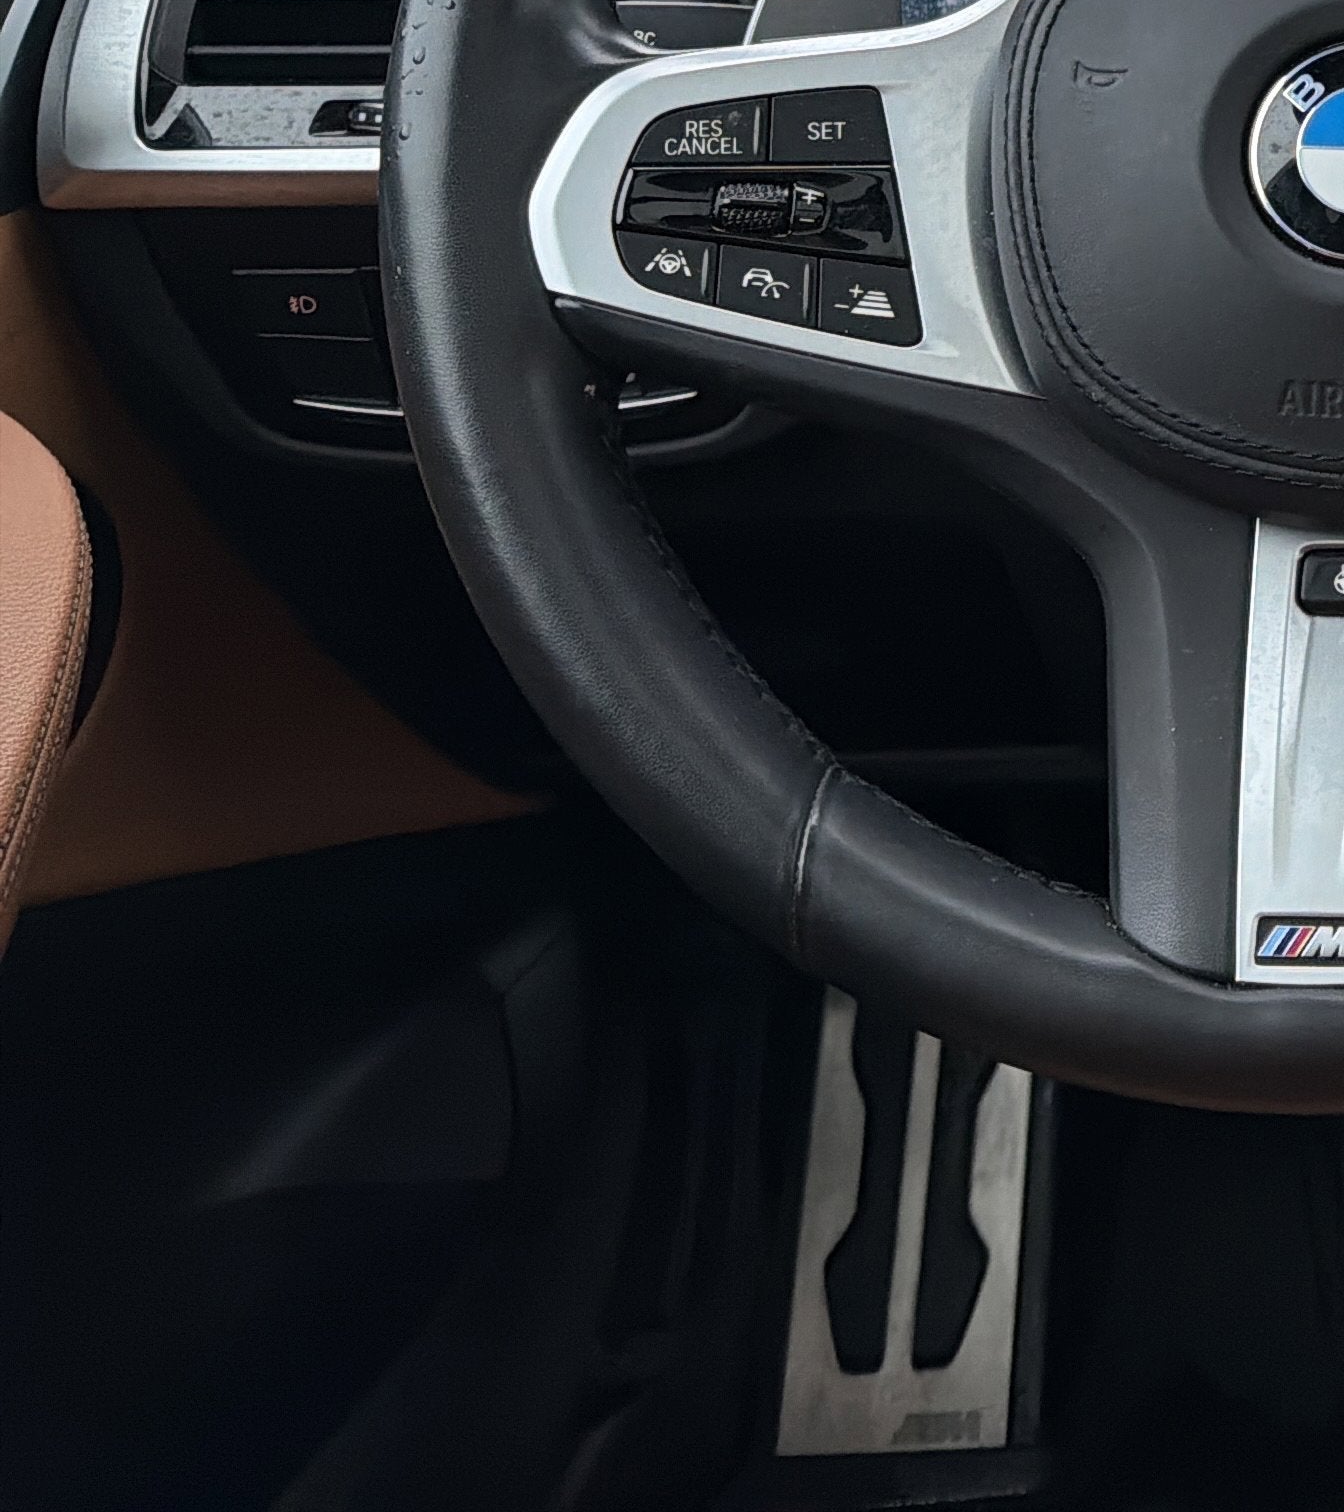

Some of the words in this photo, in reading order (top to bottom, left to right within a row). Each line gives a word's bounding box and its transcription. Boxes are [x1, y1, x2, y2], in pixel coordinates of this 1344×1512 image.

[685, 120, 723, 138] RES
[807, 121, 846, 141] SET
[664, 138, 744, 156] CANCEL
